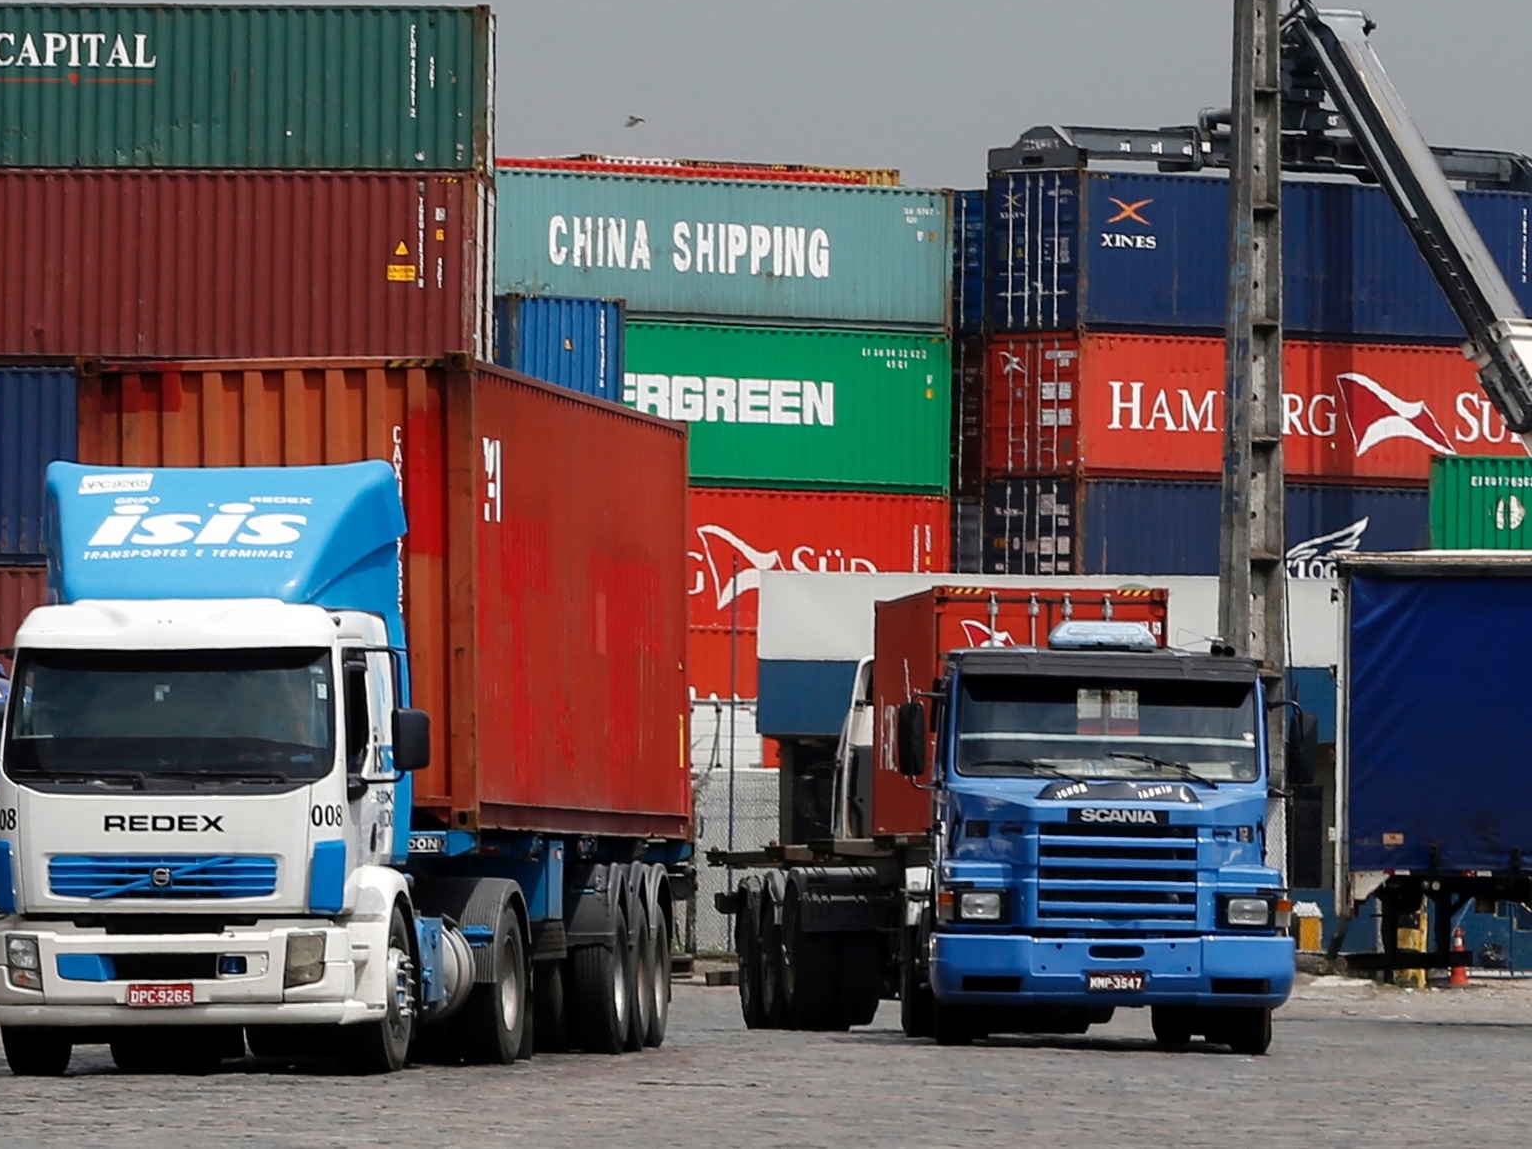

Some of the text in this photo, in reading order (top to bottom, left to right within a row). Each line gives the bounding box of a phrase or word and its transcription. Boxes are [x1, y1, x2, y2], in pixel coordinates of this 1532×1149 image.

[549, 215, 830, 278] CHINA SHIPPING
[1101, 233, 1157, 249] XINES
[1107, 380, 1336, 437] HAMRG
[249, 496, 313, 505] REDEX
[87, 502, 308, 546] isis
[83, 549, 294, 560] TRANSPORTES E TERMINAIS
[103, 814, 225, 832] REDEX
[311, 804, 343, 828] 008
[1080, 808, 1157, 823] SCANIA
[129, 989, 192, 1003] DPC-9265
